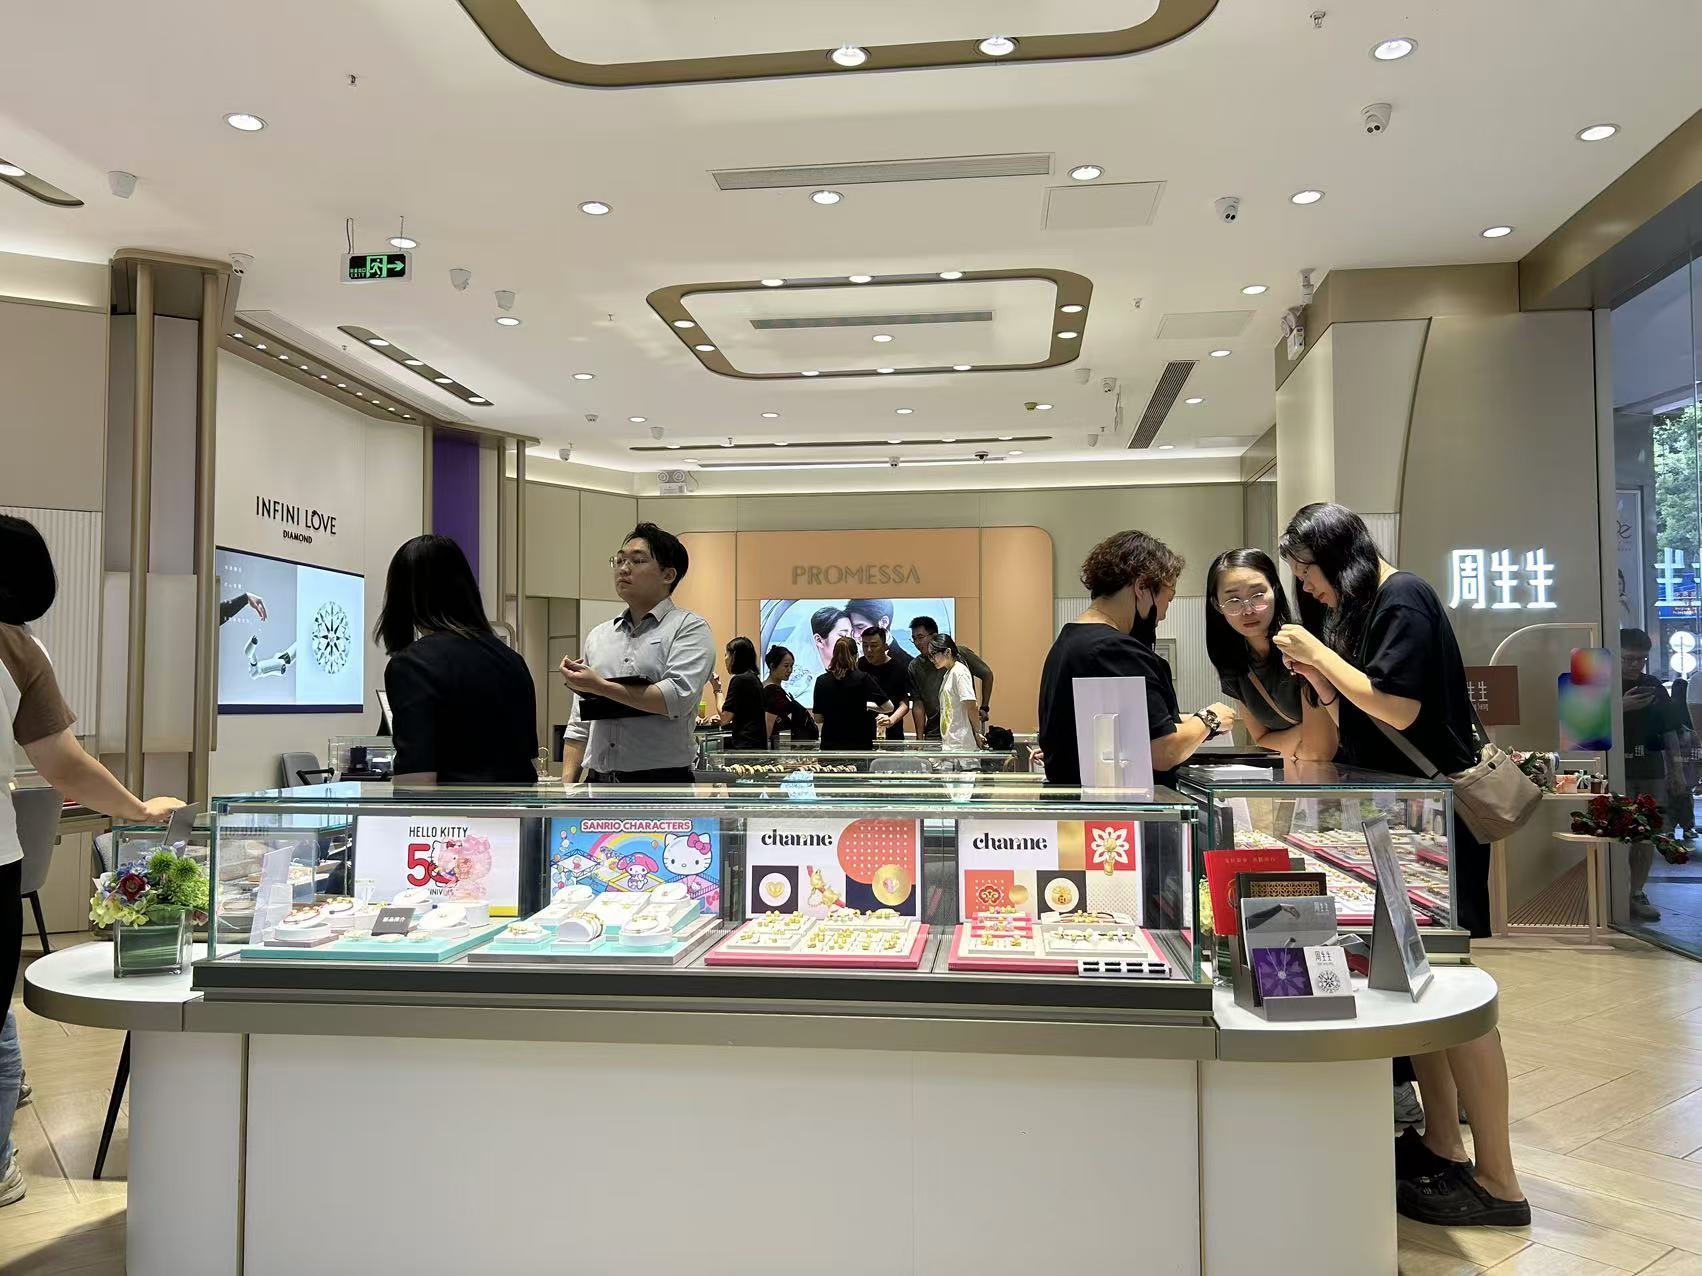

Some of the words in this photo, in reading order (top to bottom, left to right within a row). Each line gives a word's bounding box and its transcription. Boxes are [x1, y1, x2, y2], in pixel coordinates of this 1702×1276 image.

[255, 496, 300, 526] INFINI
[305, 509, 337, 535] LOVE
[282, 529, 313, 544] DIAMOND
[792, 564, 921, 586] PROMESSA
[1447, 547, 1558, 610] 周生生
[408, 826, 438, 838] HELLO
[440, 826, 469, 838] KITTY
[583, 820, 622, 831] SANRIO
[623, 821, 691, 831] CHARACTERS
[760, 828, 833, 847] charme
[972, 832, 1048, 851] charme
